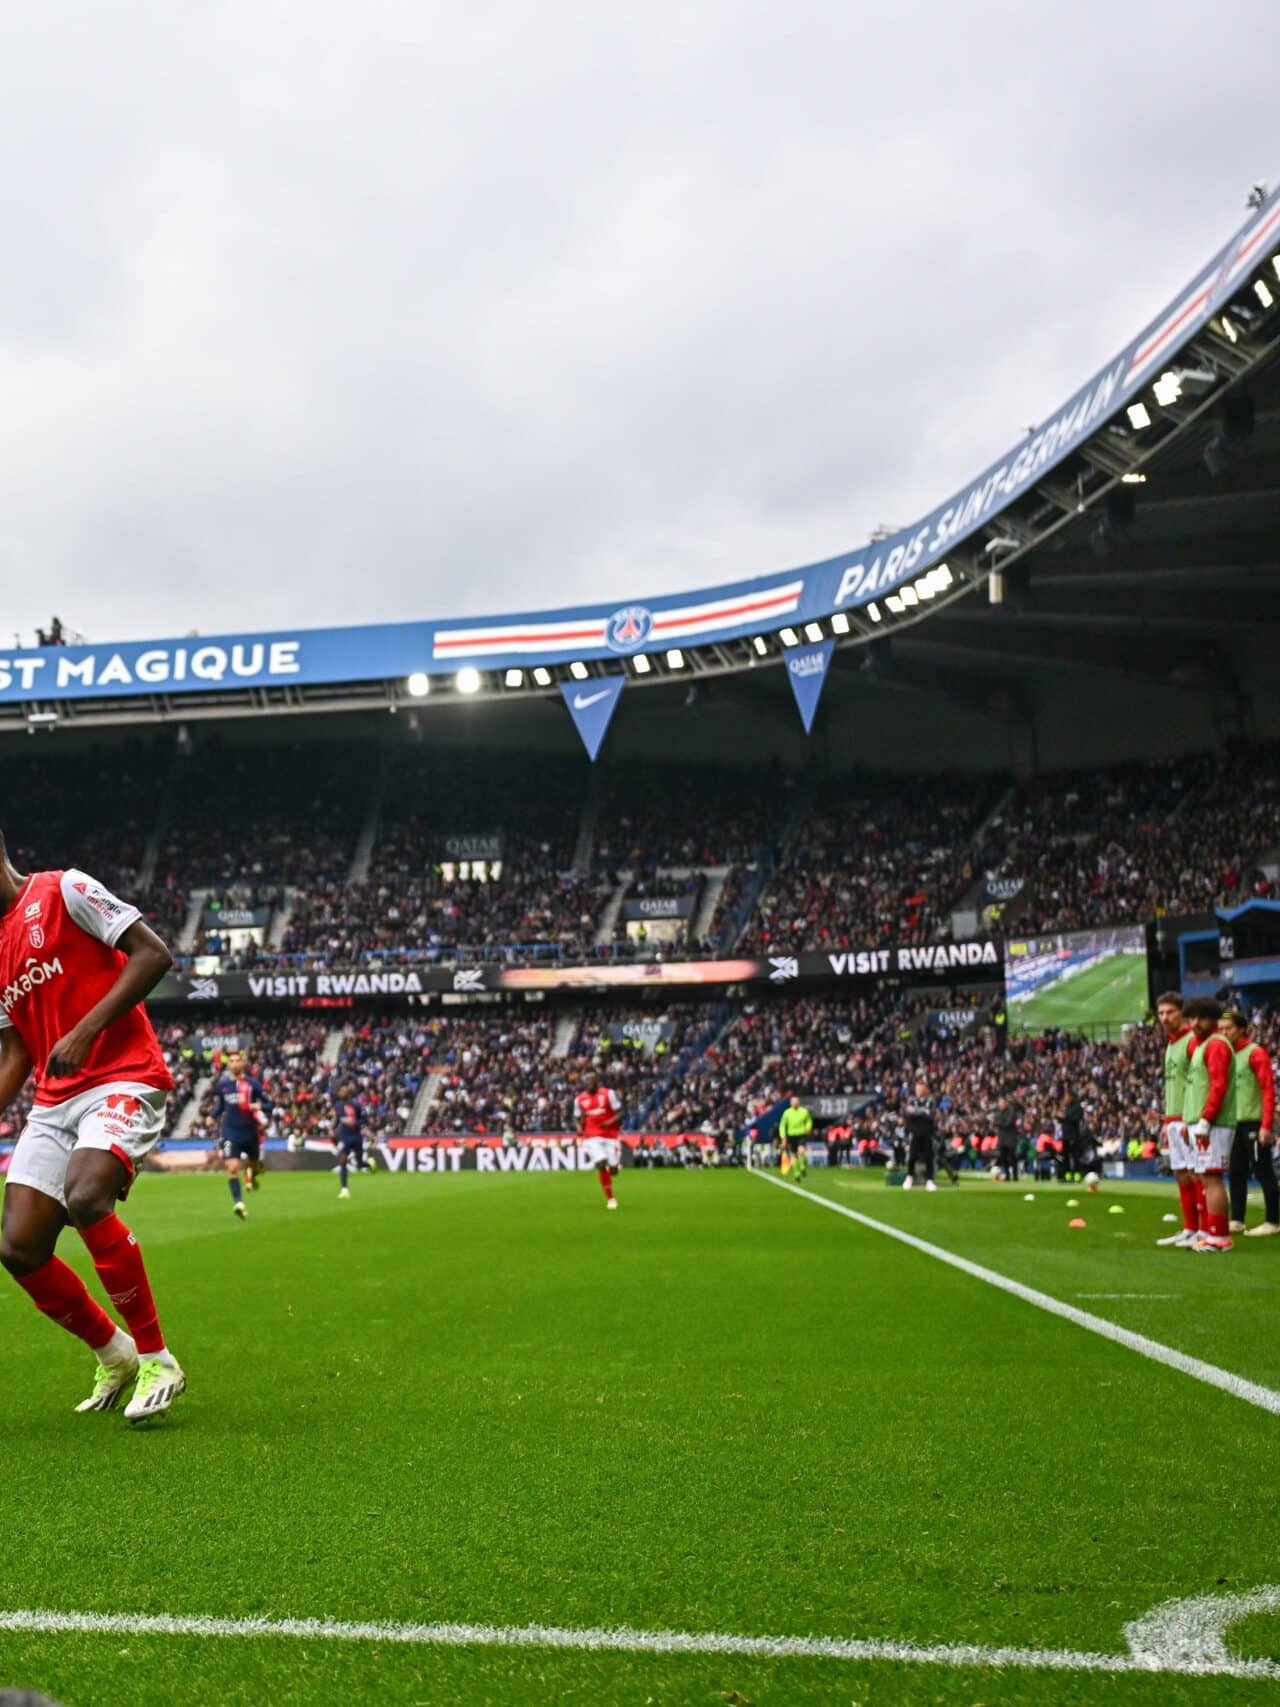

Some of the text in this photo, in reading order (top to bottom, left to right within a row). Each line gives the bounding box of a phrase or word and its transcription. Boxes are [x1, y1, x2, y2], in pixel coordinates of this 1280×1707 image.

[833, 360, 1125, 606] PARIS SAINT-GERMAIN
[57, 641, 301, 689] MAGIQUE
[638, 900, 678, 912] QATAR
[828, 941, 998, 975] VISIT RWANDA
[249, 972, 422, 997] VISIT RWANDA
[623, 1022, 661, 1038] QATAR
[381, 1146, 593, 1171] VISIT RWAND
